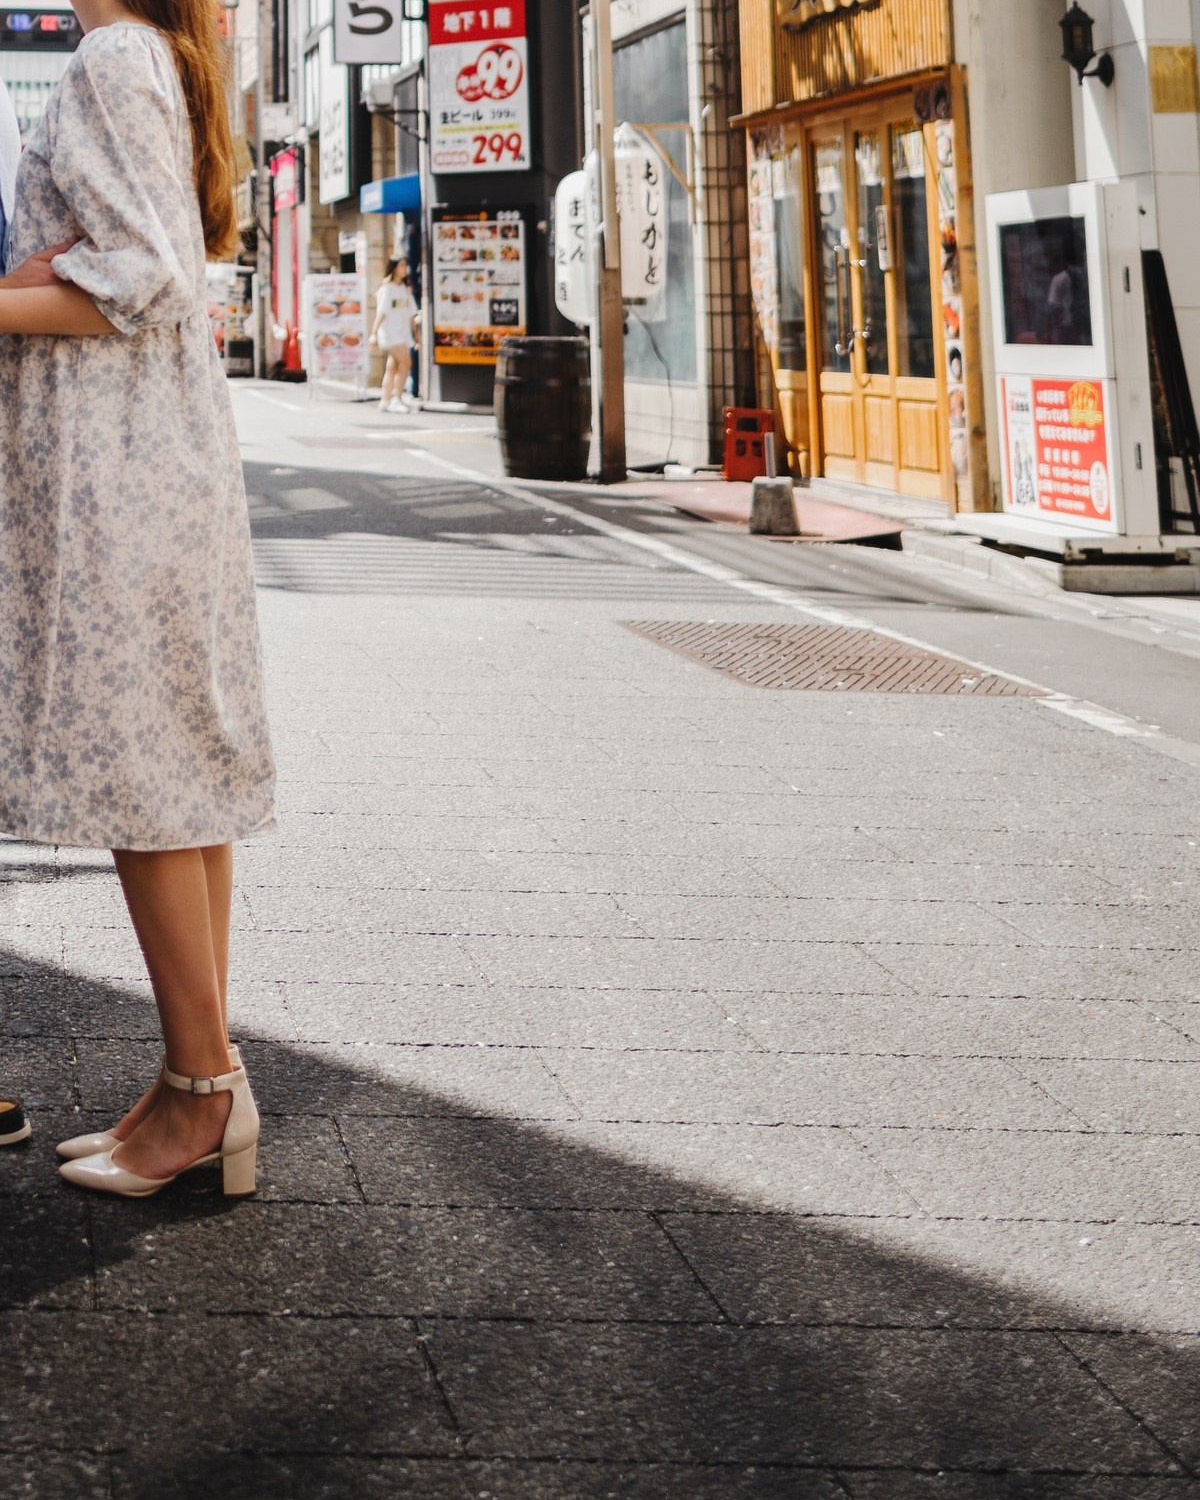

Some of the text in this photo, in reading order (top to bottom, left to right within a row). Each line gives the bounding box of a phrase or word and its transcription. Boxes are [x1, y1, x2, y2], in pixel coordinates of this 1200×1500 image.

[443, 7, 512, 33] 地下1階
[440, 109, 483, 125] 生ビール
